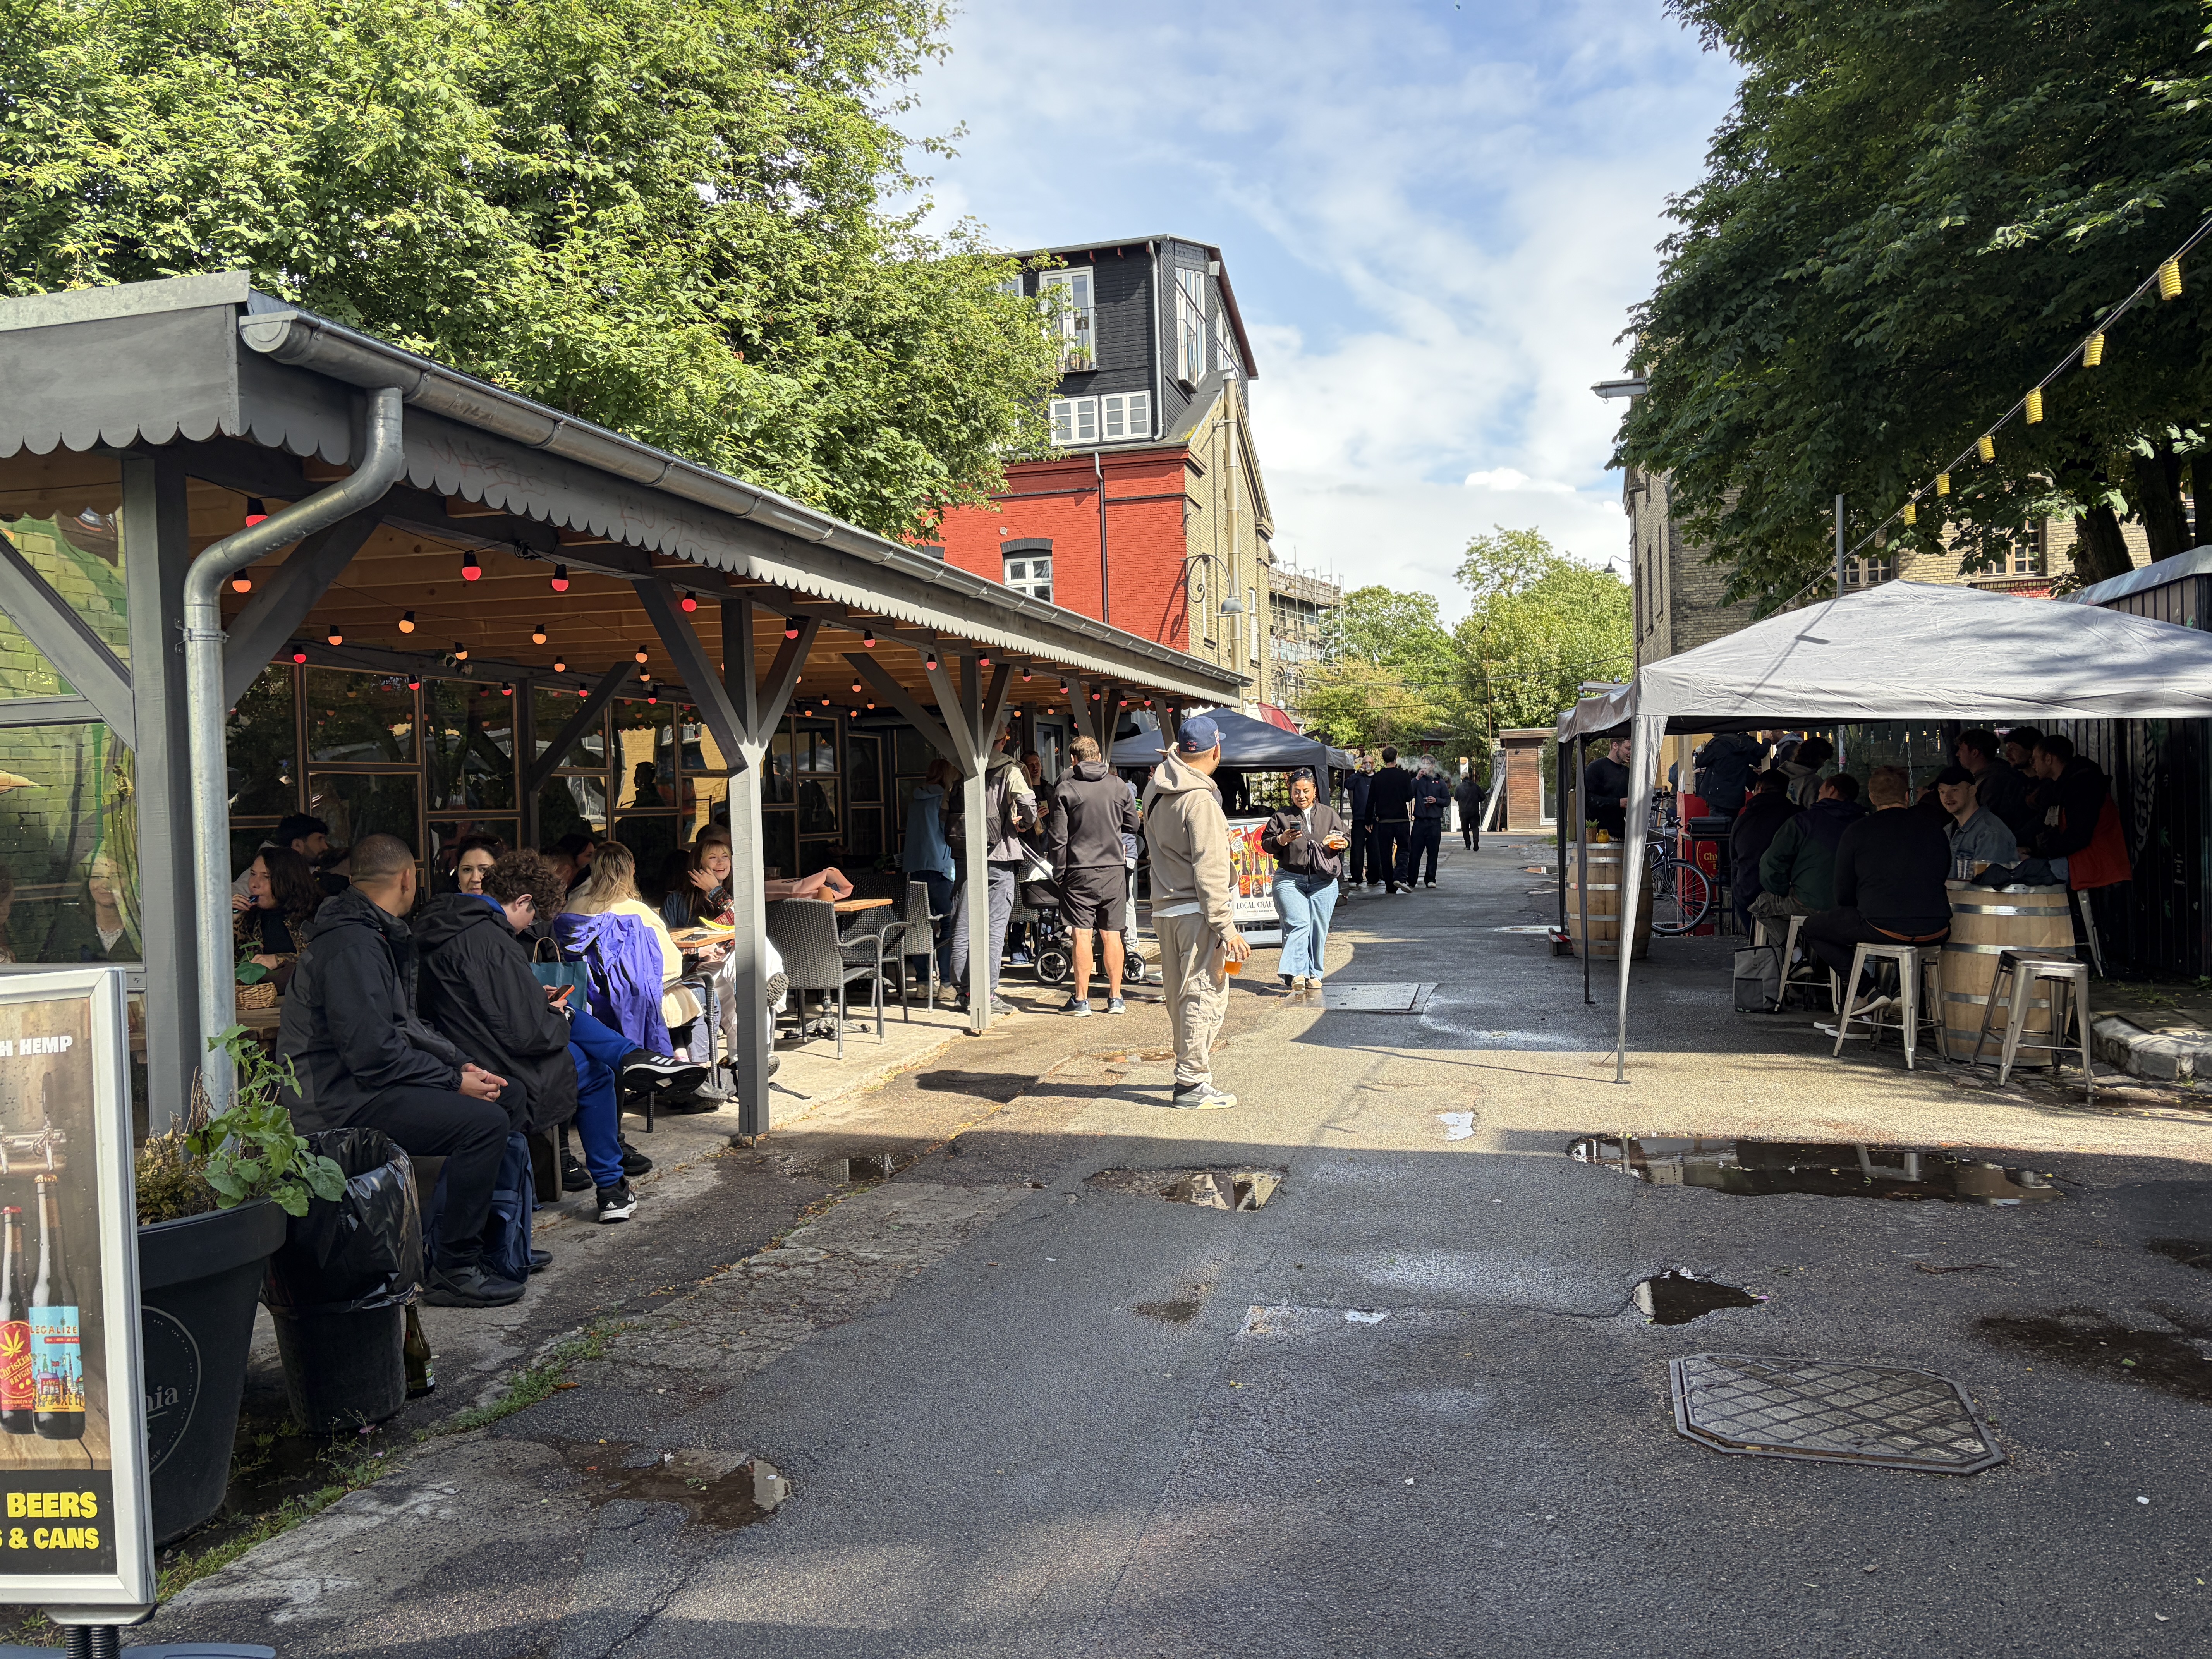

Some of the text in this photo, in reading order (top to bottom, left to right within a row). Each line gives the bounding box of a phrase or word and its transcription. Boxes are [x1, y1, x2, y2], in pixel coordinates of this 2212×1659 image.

[0, 1036, 73, 1057] H HEMP
[30, 1326, 77, 1334] LEGALIZE
[7, 1492, 98, 1518] BEERS
[9, 1527, 29, 1549] &
[34, 1527, 99, 1549] CANS
